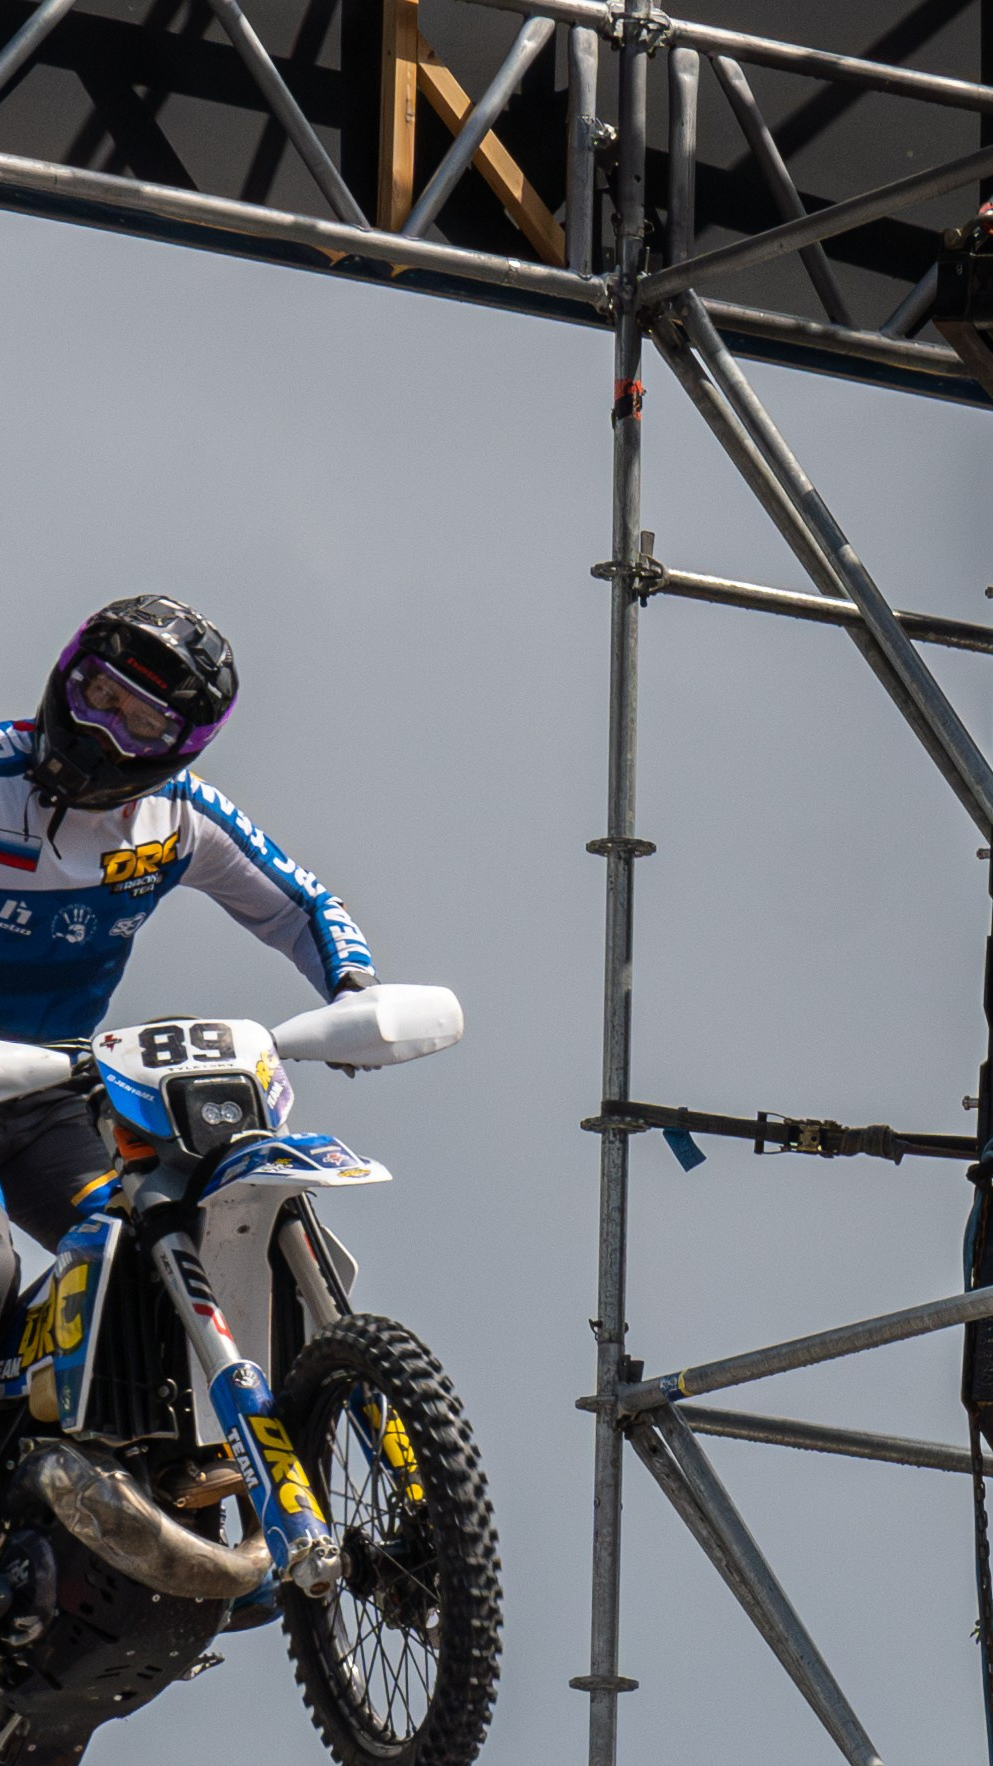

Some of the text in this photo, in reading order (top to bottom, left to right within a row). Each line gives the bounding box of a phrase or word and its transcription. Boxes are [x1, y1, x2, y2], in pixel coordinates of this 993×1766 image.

[138, 1022, 237, 1069] 89
[18, 1264, 89, 1368] DRC
[227, 1427, 259, 1489] TEAM
[249, 1416, 327, 1524] DRC
